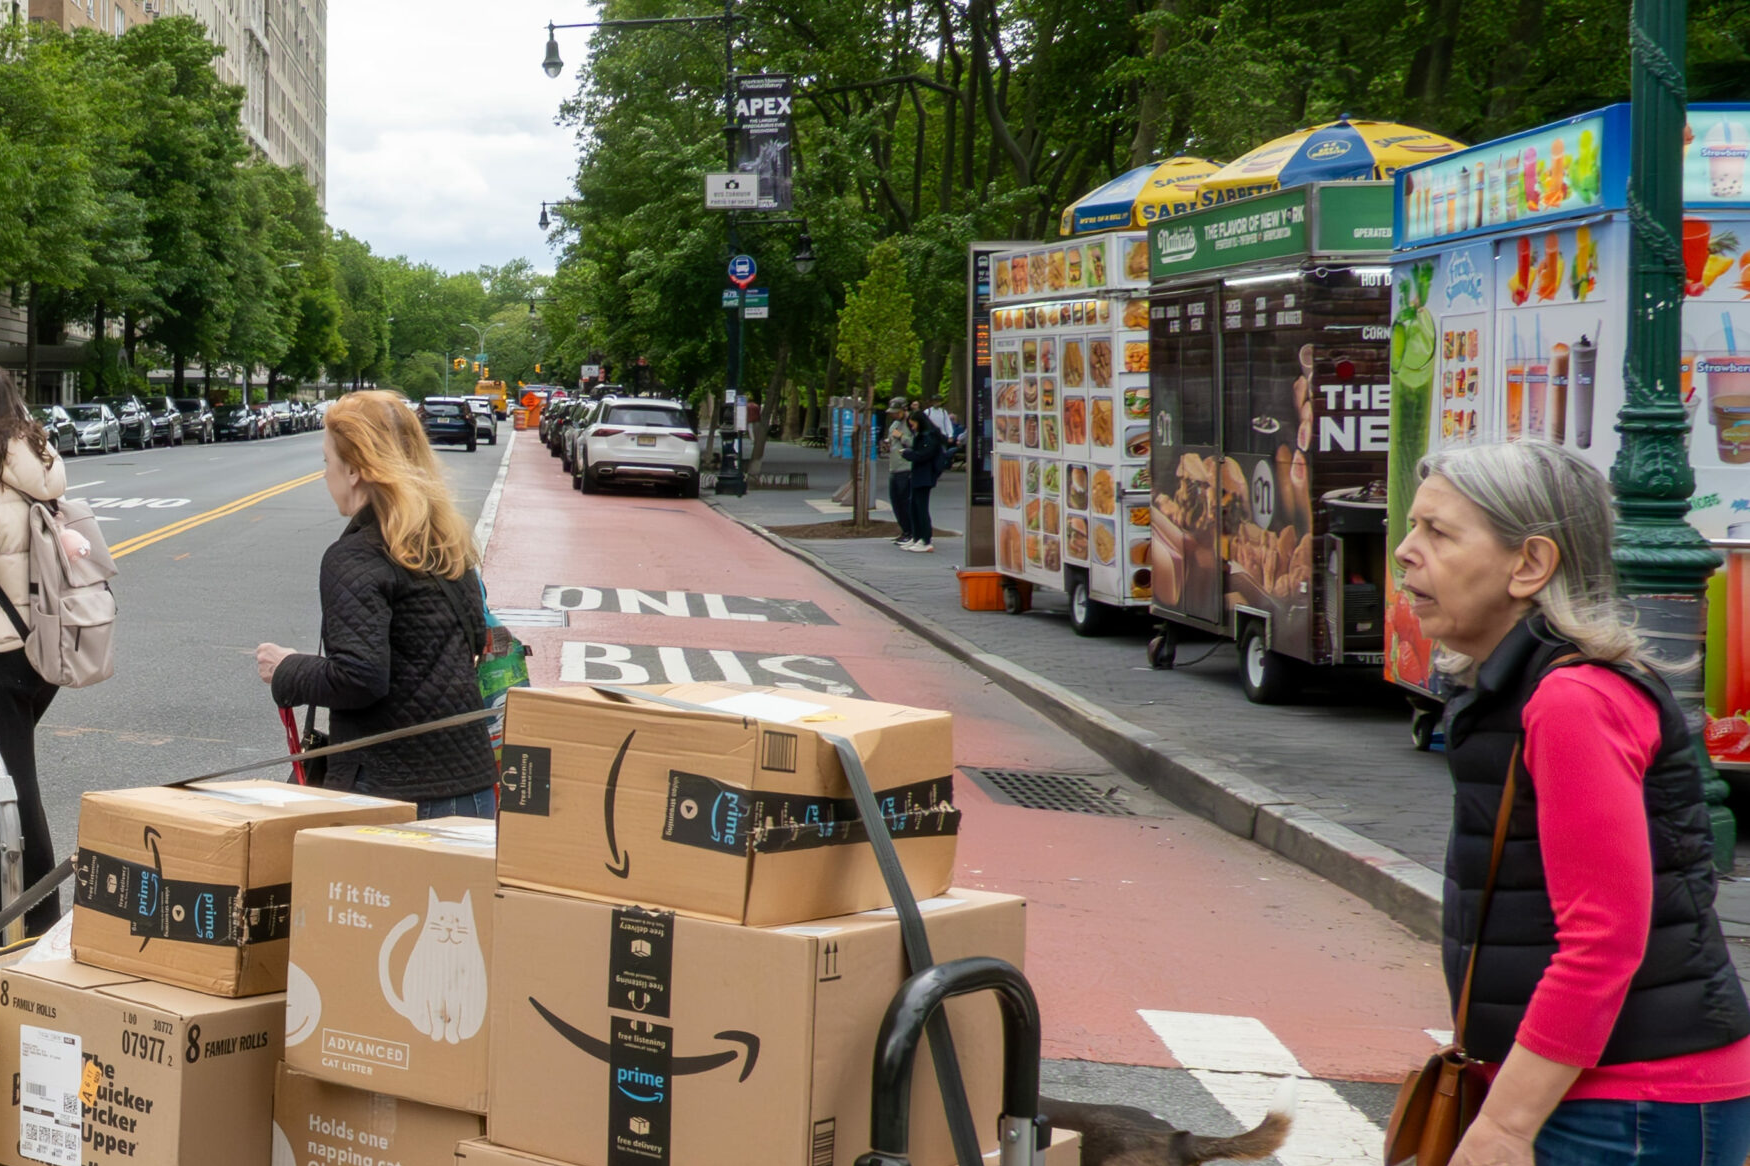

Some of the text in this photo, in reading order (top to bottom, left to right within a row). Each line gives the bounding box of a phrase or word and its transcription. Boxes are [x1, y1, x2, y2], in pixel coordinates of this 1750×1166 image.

[736, 97, 791, 117] APEX
[1701, 147, 1750, 159] Strawberry
[1204, 223, 1218, 240] THE
[1219, 217, 1247, 238] FLAVOR
[1249, 214, 1260, 232] OF
[1261, 210, 1280, 230] NEW
[1354, 228, 1392, 238] OPERATED
[1361, 273, 1381, 287] HOT
[1362, 326, 1391, 340] CORN
[1320, 385, 1390, 410] THE
[1320, 416, 1389, 452] NE
[559, 641, 854, 697] BUS
[520, 753, 528, 789] listening
[724, 791, 738, 845] prime
[138, 871, 150, 917] prime
[329, 882, 391, 908] If it fits
[203, 893, 215, 940] prime
[328, 906, 373, 929] I sits.
[620, 921, 664, 938] free delivery
[615, 974, 663, 992] free listening
[0, 980, 56, 1019] 8 FAMILY ROLLS
[123, 1011, 174, 1035] 1 00 30772
[122, 1029, 173, 1067] 07977 2
[185, 1024, 268, 1064] 8 FAMILY ROLLS
[327, 1035, 403, 1062] ADVANCED
[617, 1031, 633, 1041] free
[634, 1034, 666, 1050] listening
[322, 1057, 372, 1075] CAT LITTER
[617, 1067, 664, 1088] prime
[82, 1090, 93, 1103] A
[96, 1081, 153, 1114] uicker
[81, 1102, 137, 1133] Picker
[81, 1121, 136, 1157] Upper
[309, 1113, 388, 1150] Holds one
[617, 1135, 662, 1154] free delivery
